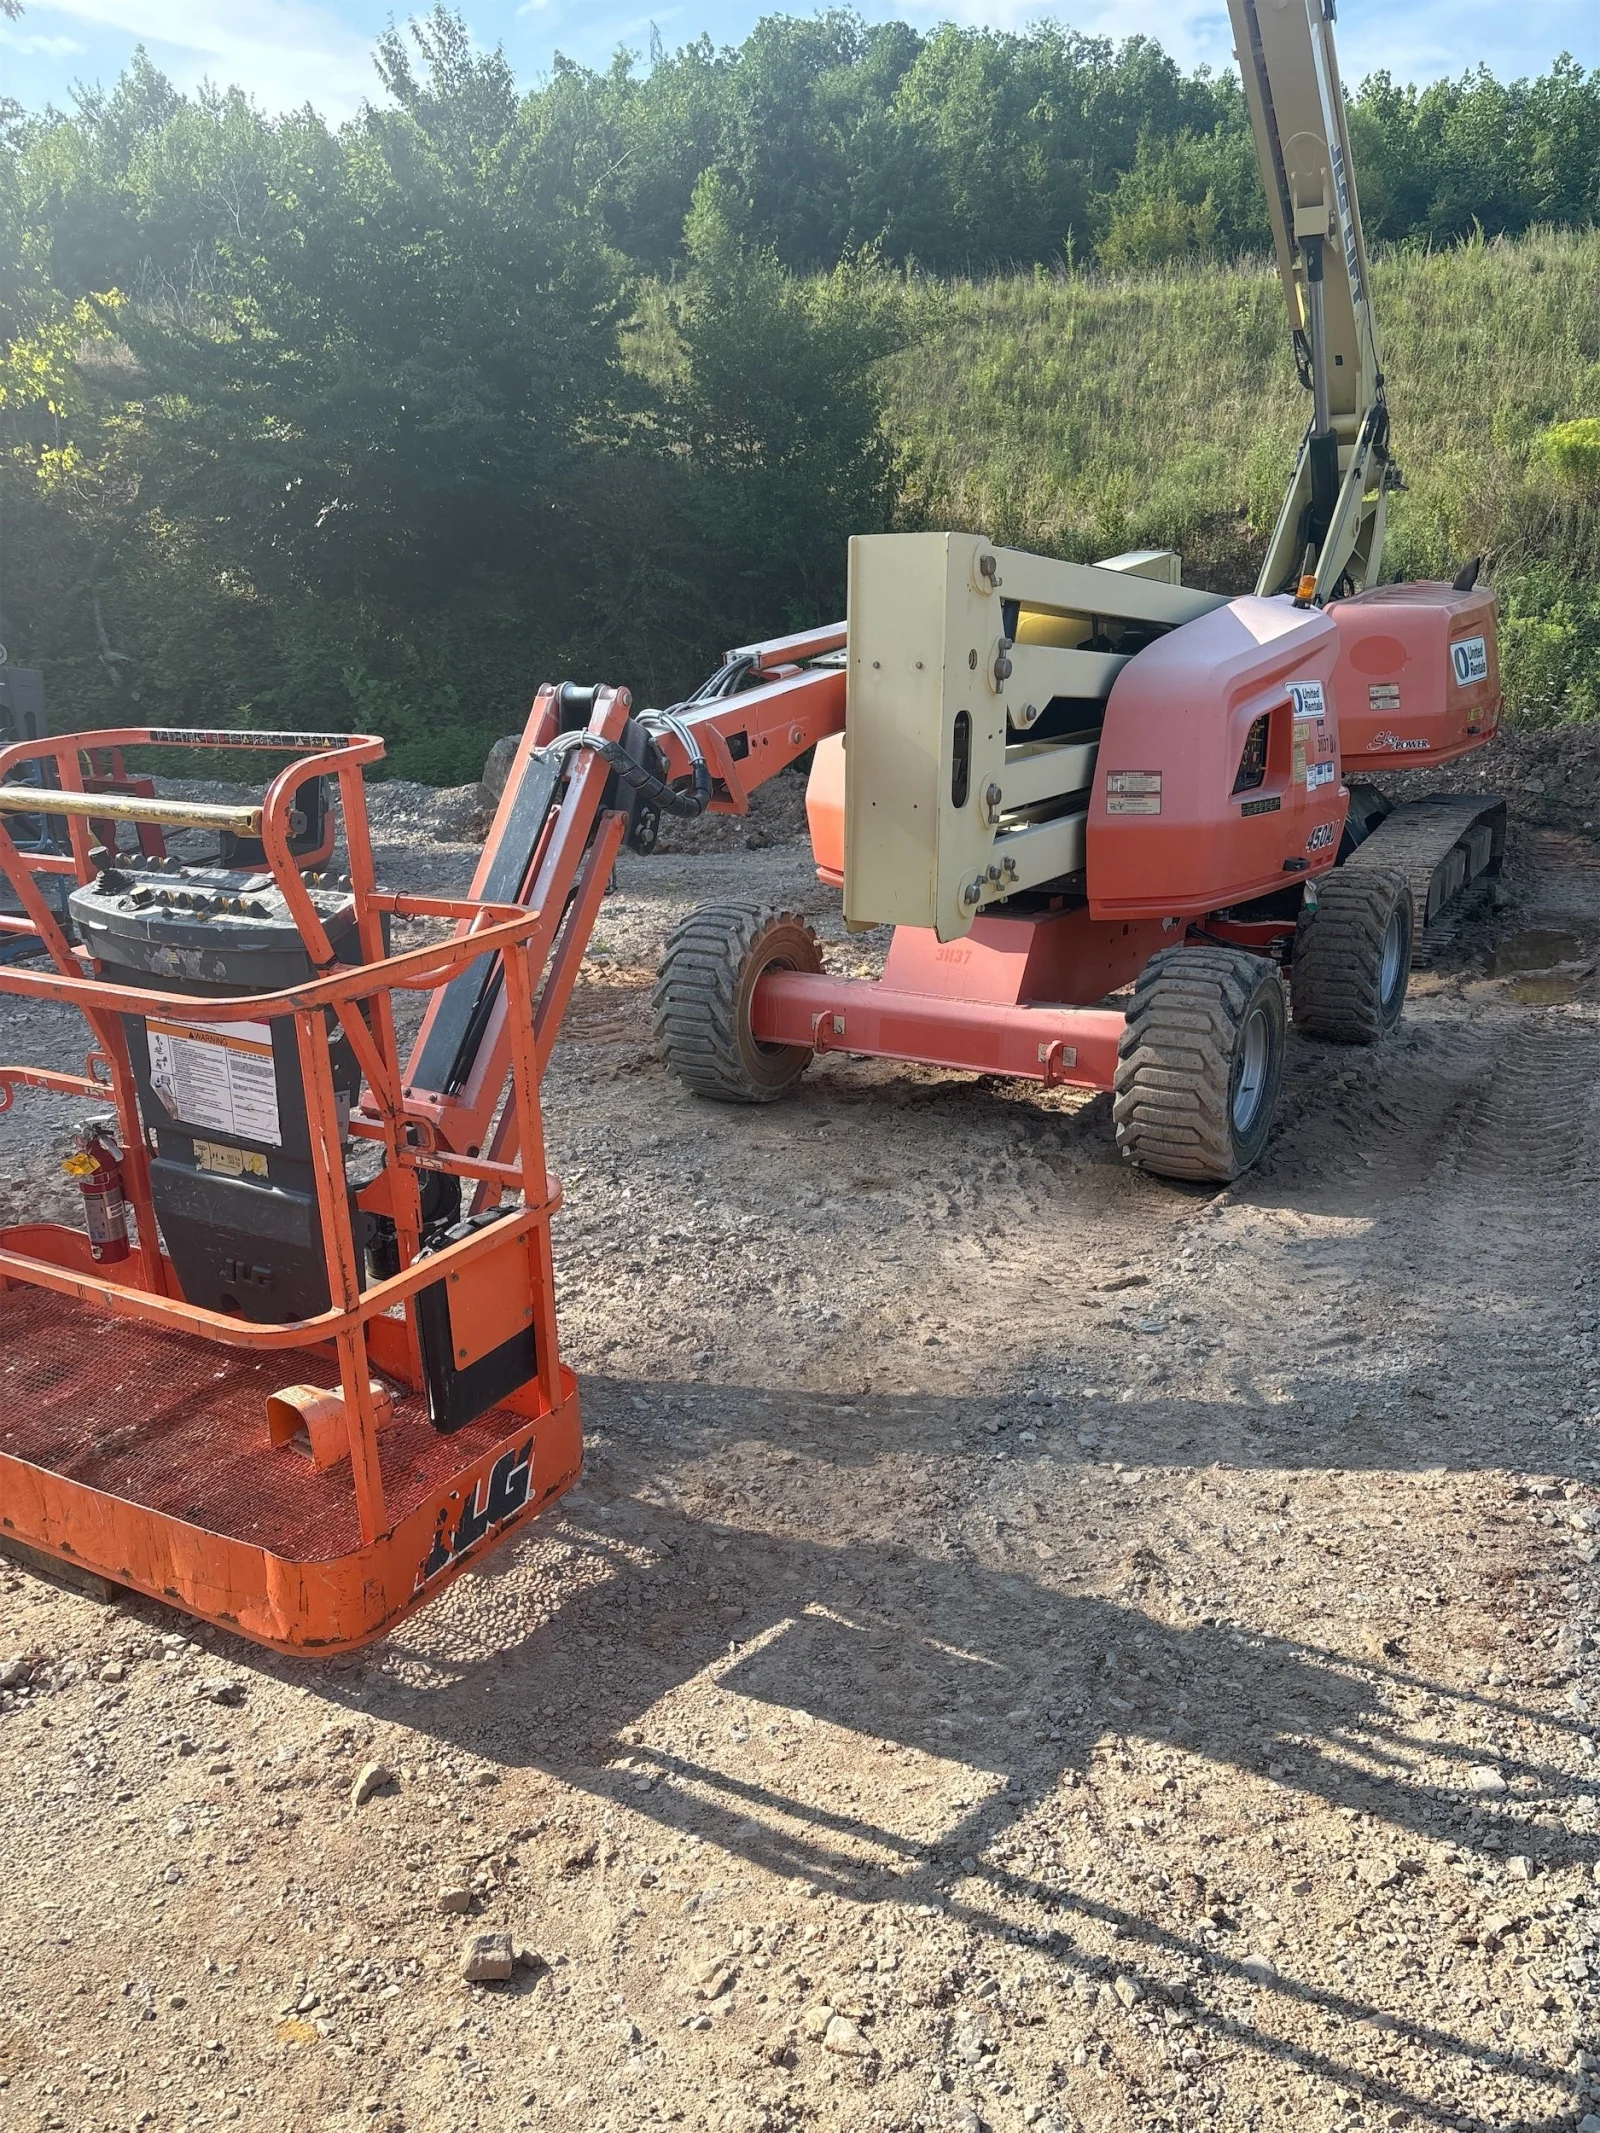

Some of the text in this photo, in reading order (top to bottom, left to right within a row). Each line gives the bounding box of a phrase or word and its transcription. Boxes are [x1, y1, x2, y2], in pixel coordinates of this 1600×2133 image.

[1330, 143, 1363, 305] JLG LIFT
[1467, 643, 1483, 660] United
[1470, 661, 1486, 677] Rentals
[1302, 687, 1320, 700] United
[1304, 700, 1323, 712] Rentals
[1306, 819, 1340, 853] 450AJ
[194, 1031, 228, 1047] WARNING
[220, 1257, 273, 1290] JLG
